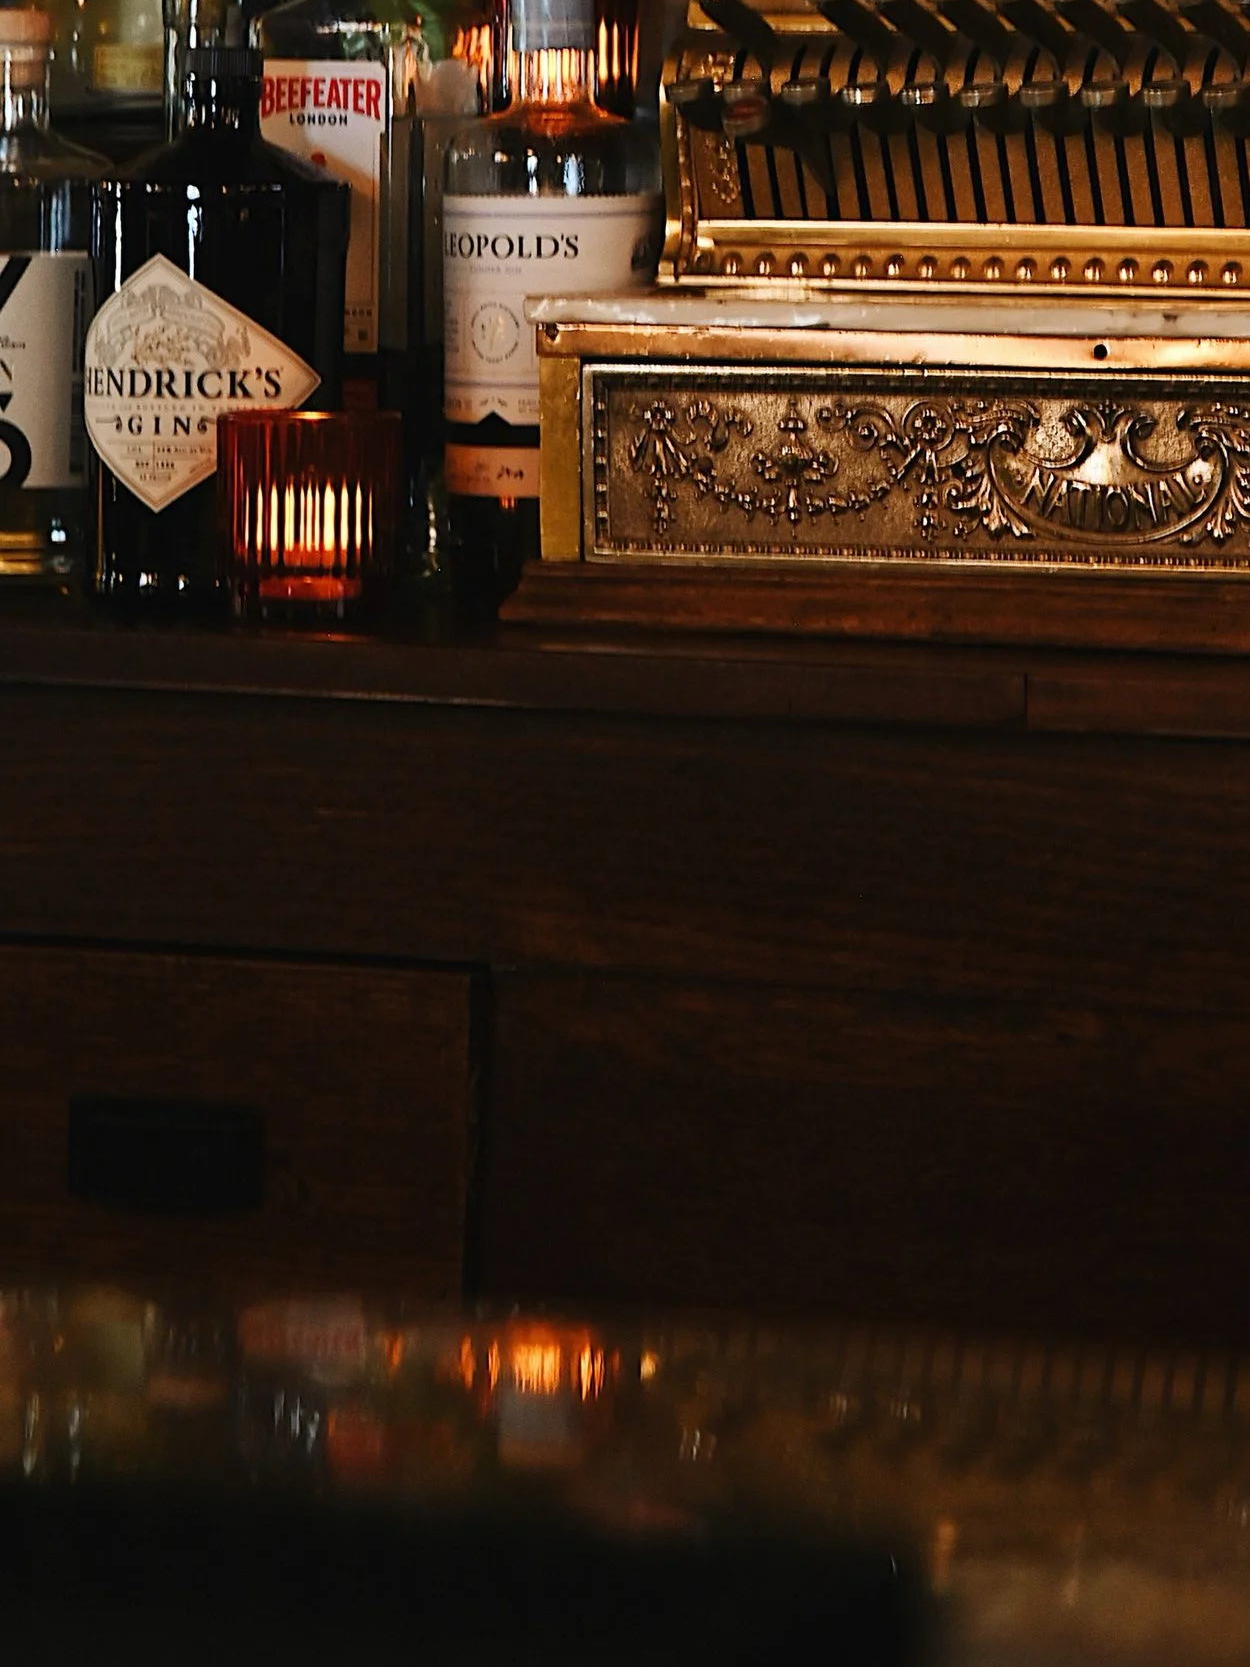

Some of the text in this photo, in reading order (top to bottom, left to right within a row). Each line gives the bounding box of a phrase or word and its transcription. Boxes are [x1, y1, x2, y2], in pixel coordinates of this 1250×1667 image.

[261, 75, 382, 122] BEEFEATER
[289, 112, 349, 127] LONDON
[86, 366, 283, 400] HENDRICK'S
[128, 415, 191, 436] GIN
[1019, 466, 1206, 531] NATIONAL
